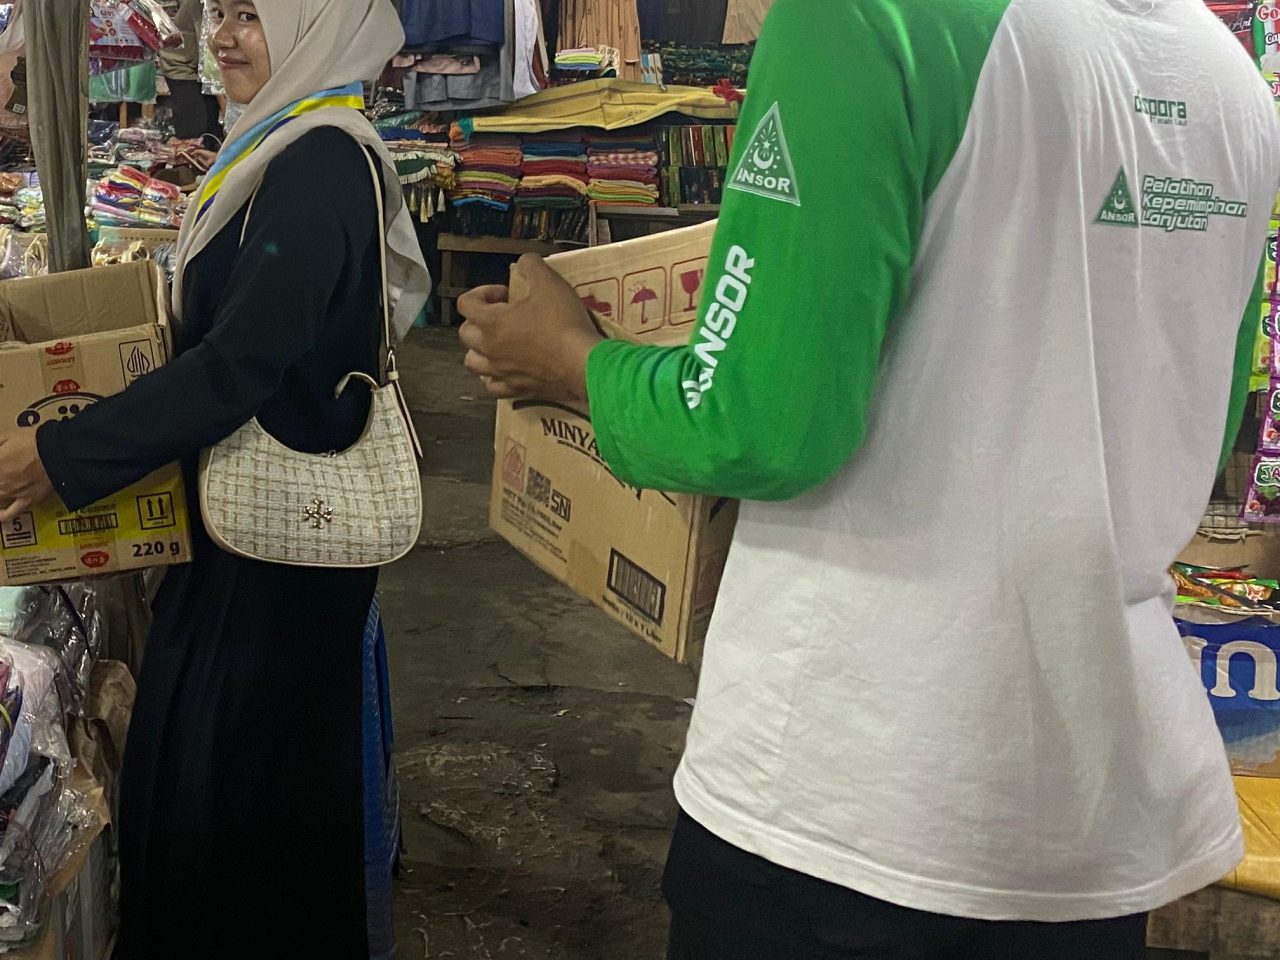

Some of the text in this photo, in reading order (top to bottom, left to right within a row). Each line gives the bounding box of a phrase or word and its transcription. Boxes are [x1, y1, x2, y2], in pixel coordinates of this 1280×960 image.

[736, 167, 791, 193] ANSOR
[1143, 175, 1213, 197] Pelatihan
[1142, 193, 1247, 218] Kepemimpinan
[1141, 209, 1208, 231] Lanjutan
[541, 417, 601, 458] MINYA
[13, 517, 22, 531] 5
[132, 542, 181, 558] 220 g
